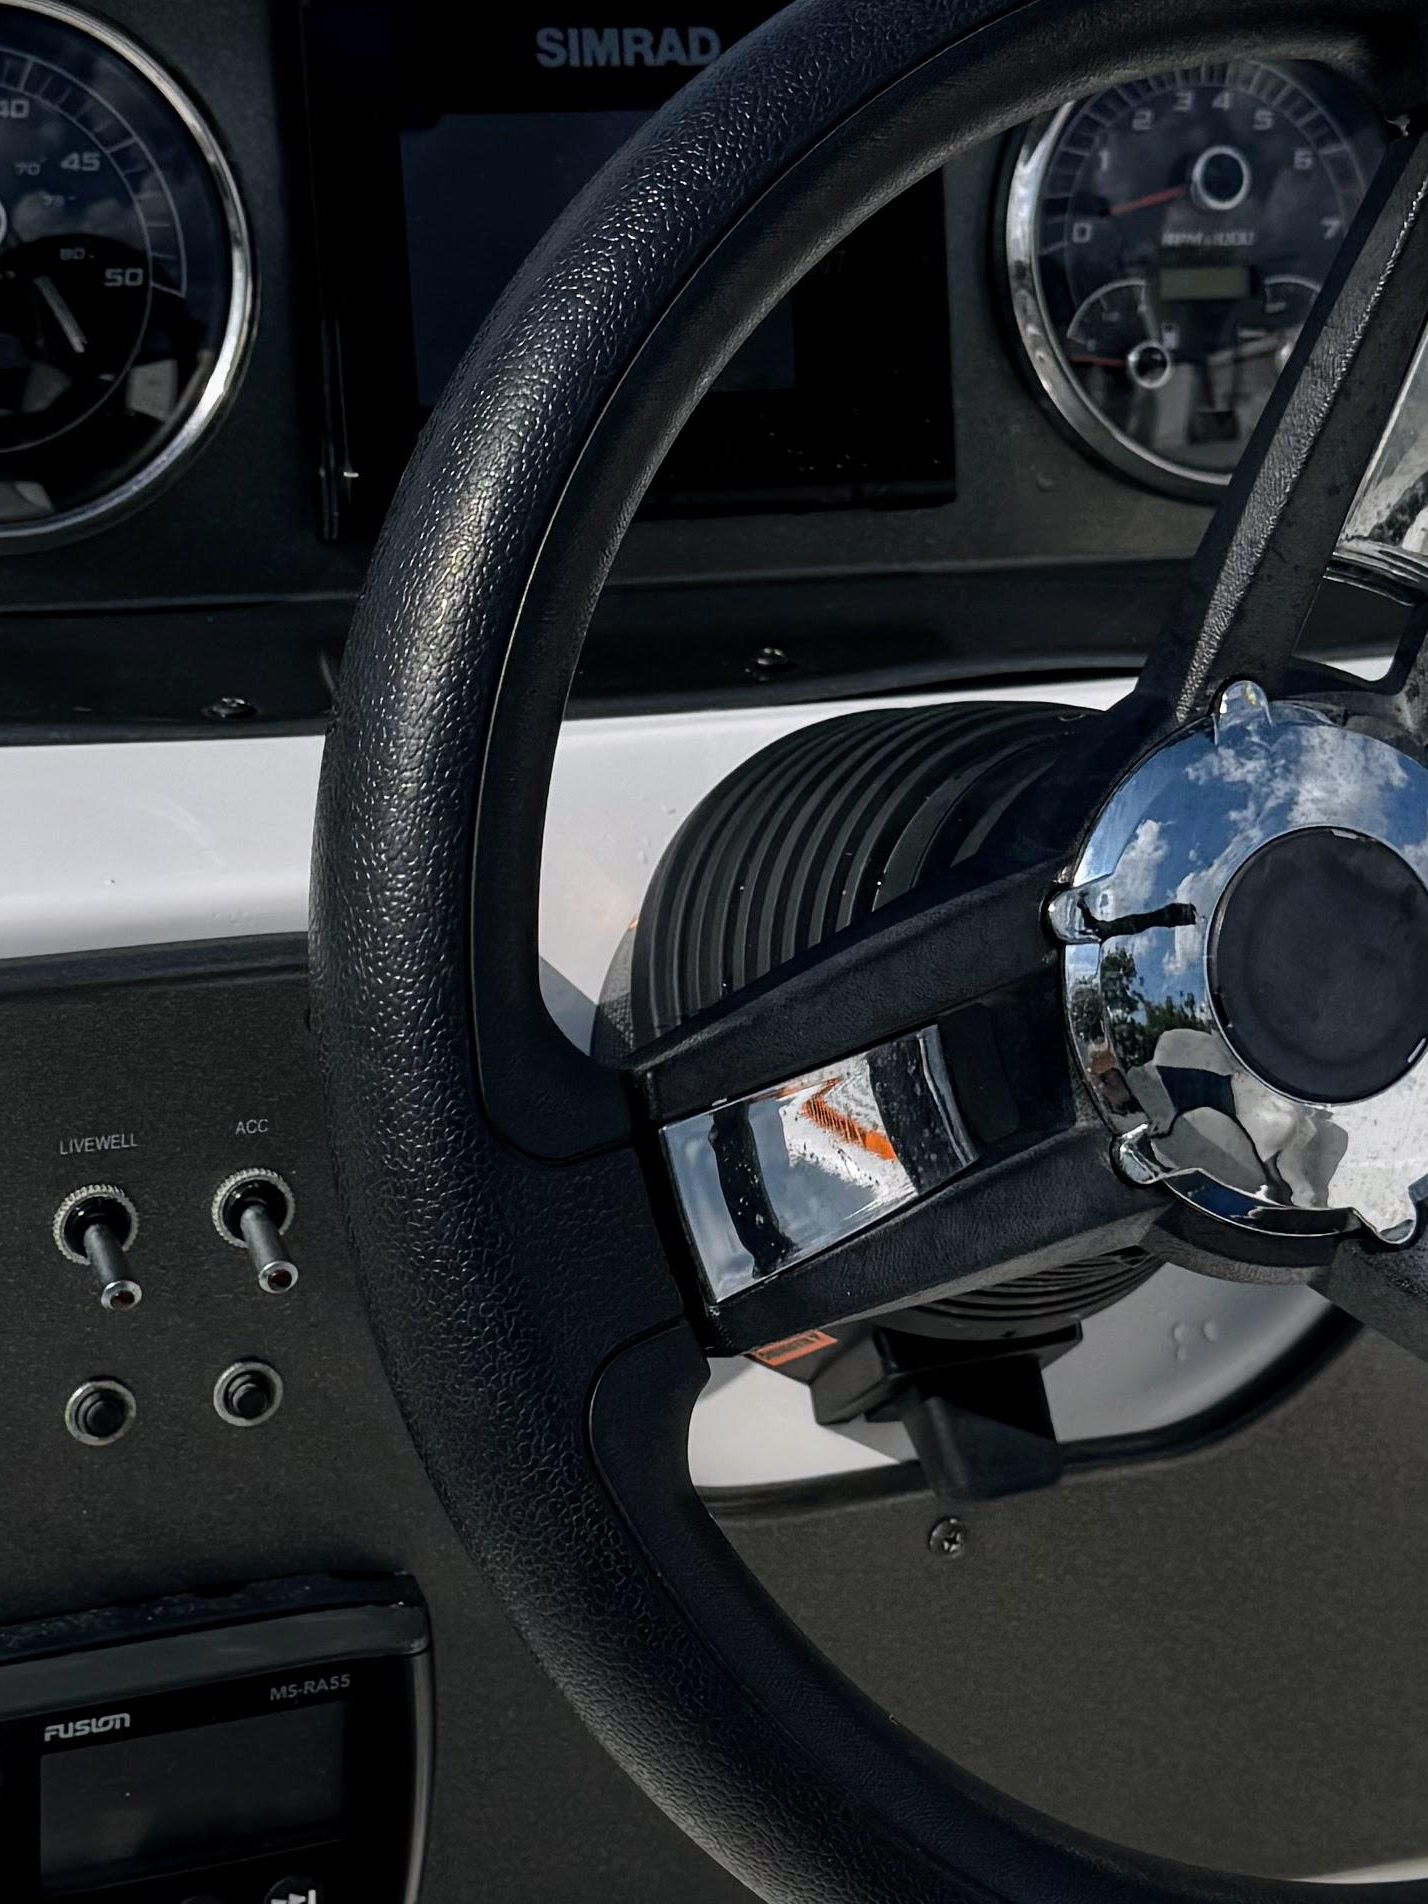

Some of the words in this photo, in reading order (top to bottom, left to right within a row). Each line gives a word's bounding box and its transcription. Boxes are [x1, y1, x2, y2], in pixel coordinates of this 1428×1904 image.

[536, 27, 722, 68] SIMRAD
[1175, 93, 1193, 112] 3
[1213, 91, 1231, 109] 4
[1132, 110, 1153, 131] 2
[1255, 110, 1274, 131] 5
[60, 152, 100, 171] 45
[1099, 150, 1109, 172] 1
[1294, 151, 1313, 170] 6
[1073, 222, 1092, 243] 0
[1321, 218, 1341, 239] 7
[104, 268, 143, 287] 50
[59, 1132, 138, 1155] LIVEWELL
[234, 1118, 270, 1136] ACC
[270, 1673, 351, 1701] MS-RA55
[44, 1712, 131, 1742] FUSION
